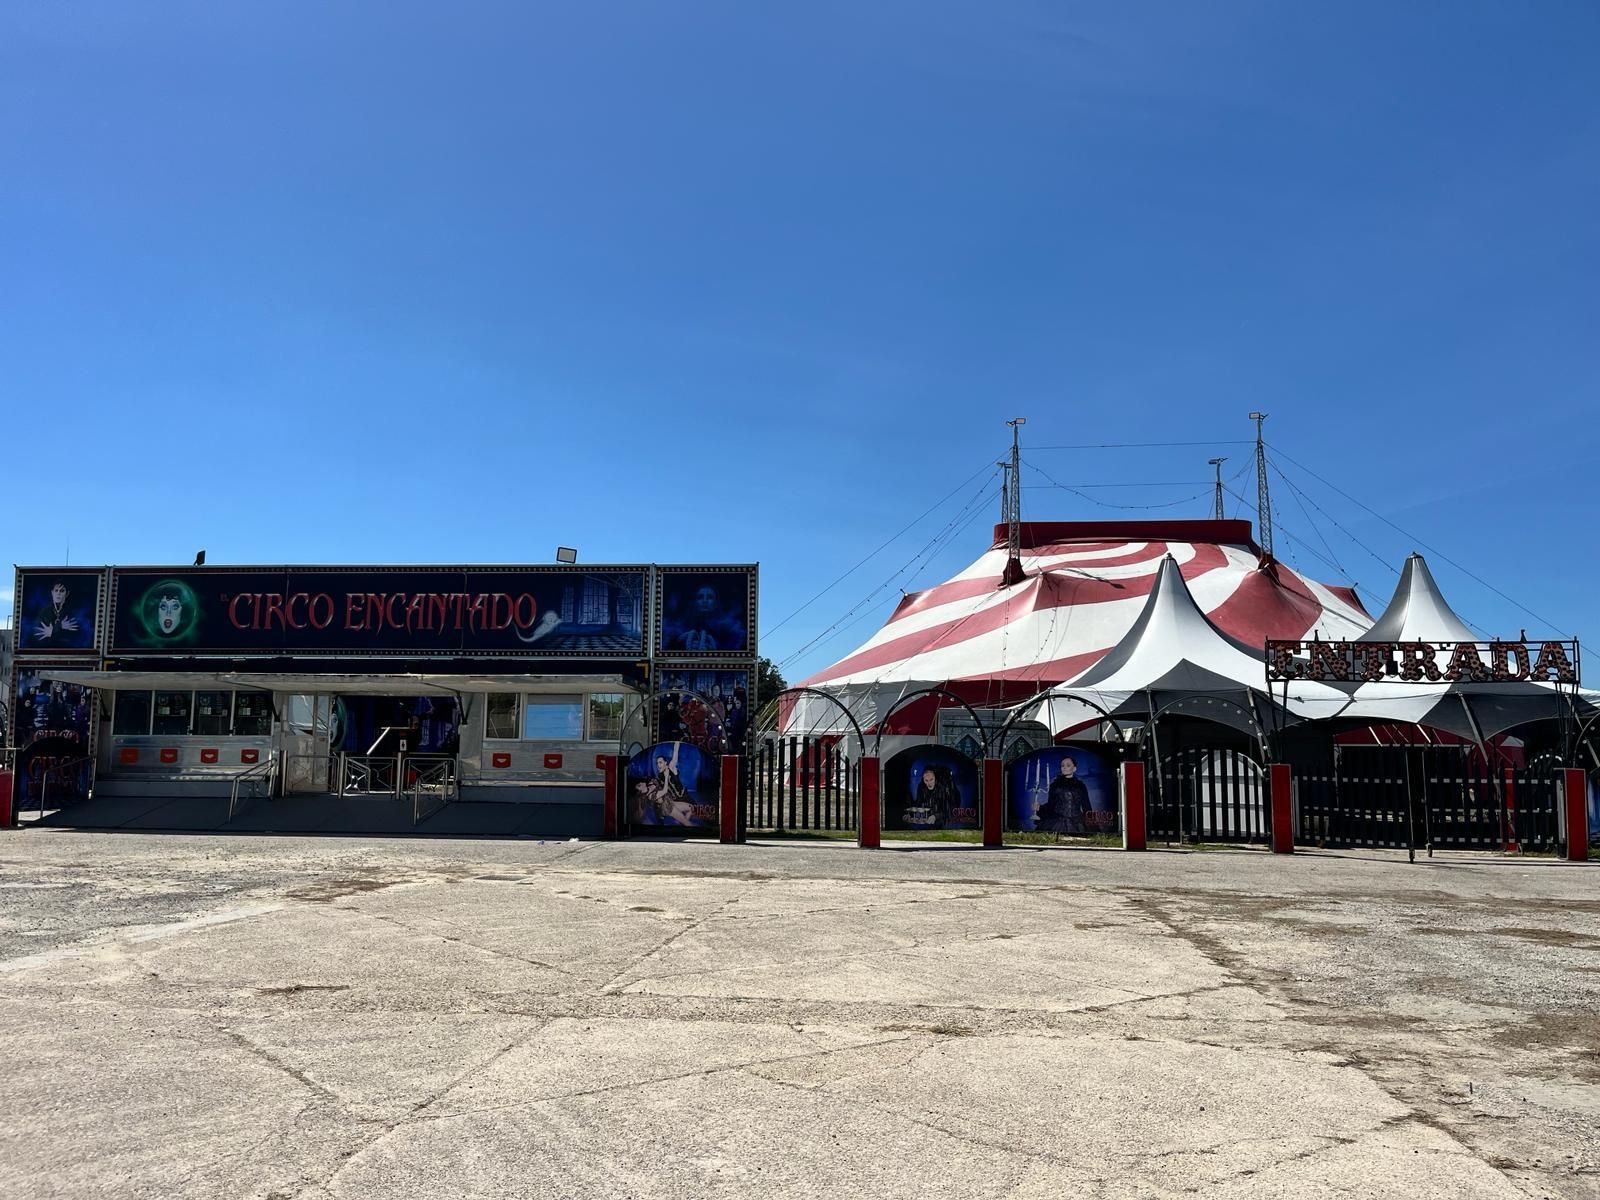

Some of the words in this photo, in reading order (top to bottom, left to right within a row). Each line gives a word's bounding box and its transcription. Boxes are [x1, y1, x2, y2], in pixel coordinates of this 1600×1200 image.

[228, 592, 335, 633] CIRCO
[343, 592, 538, 636] ENCANTADO
[1269, 641, 1576, 682] ENTRADA
[952, 807, 977, 817] CIRCO
